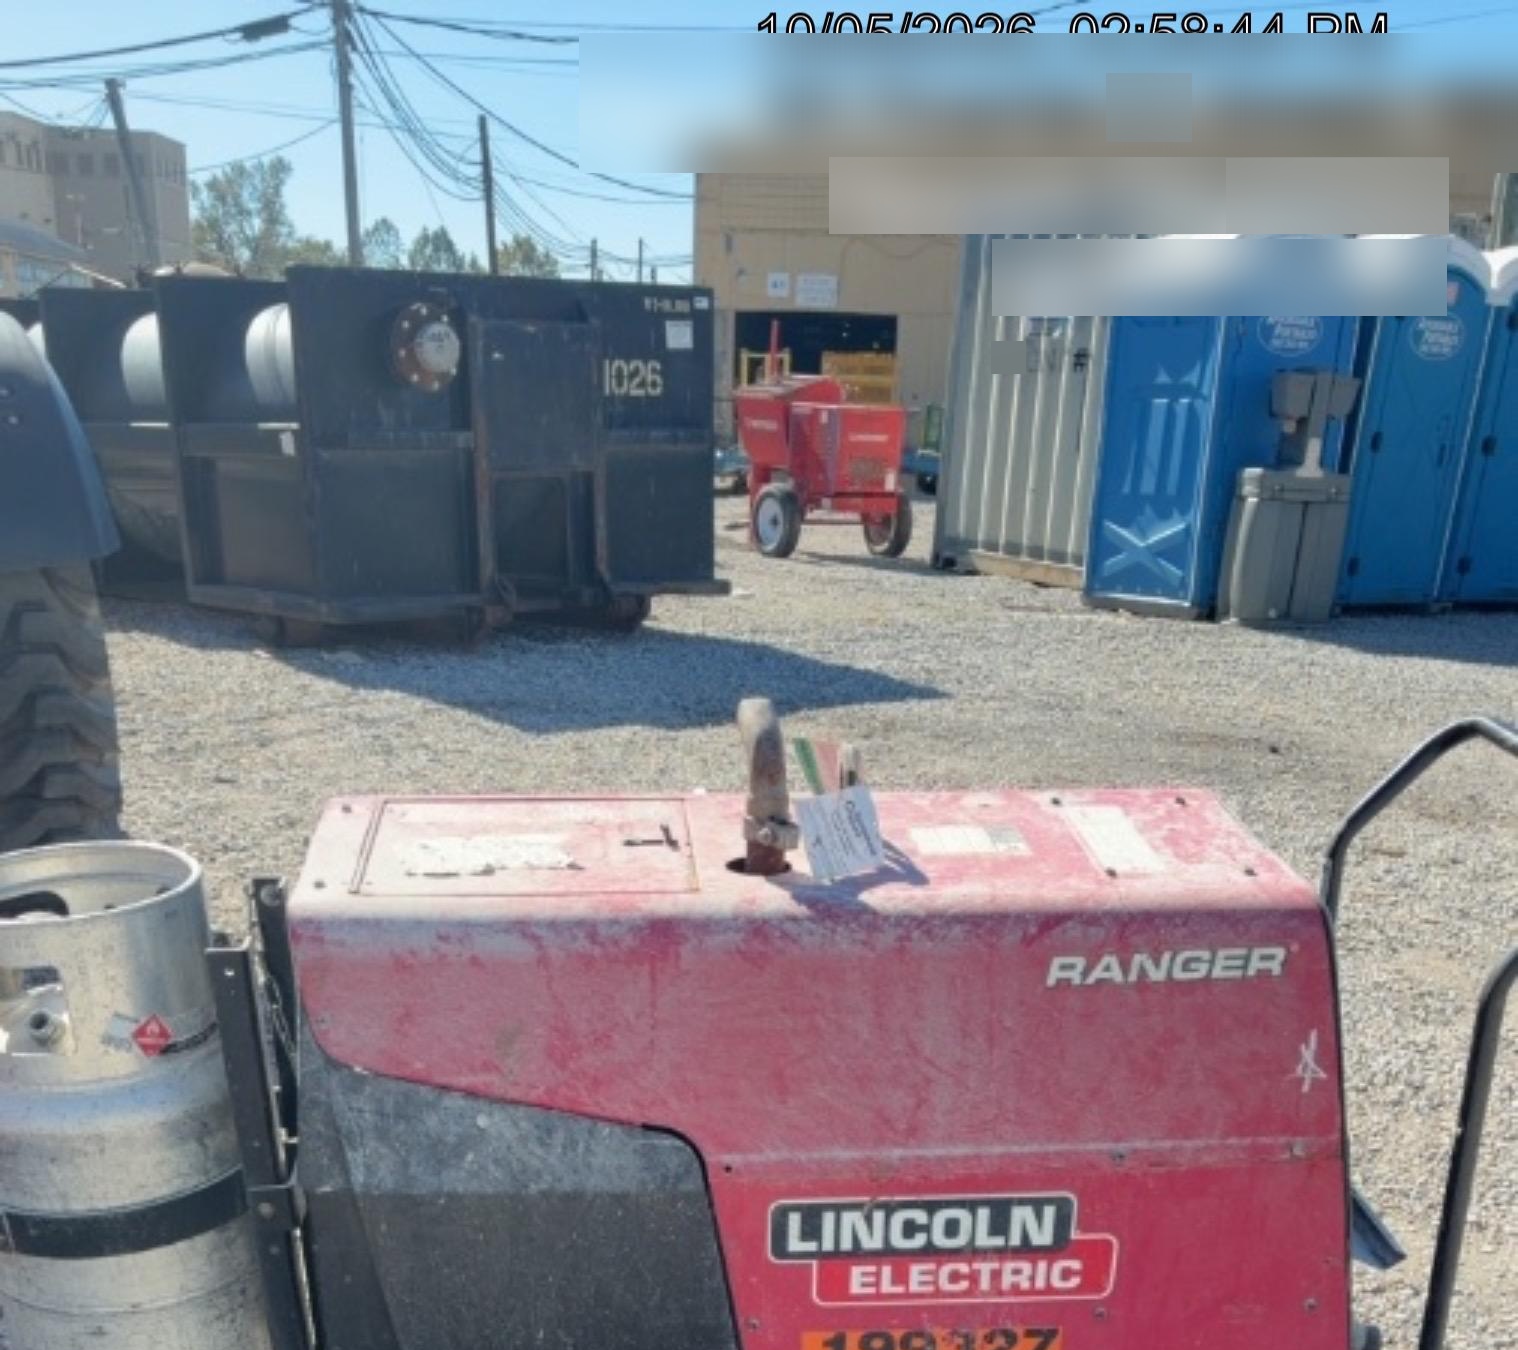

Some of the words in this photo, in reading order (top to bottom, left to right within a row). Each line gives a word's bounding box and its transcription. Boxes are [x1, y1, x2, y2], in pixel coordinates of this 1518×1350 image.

[605, 359, 663, 396] 1026
[1046, 947, 1287, 988] RANGER
[788, 1205, 1057, 1252] LINCOLN
[850, 1259, 1083, 1294] ELECTRIC
